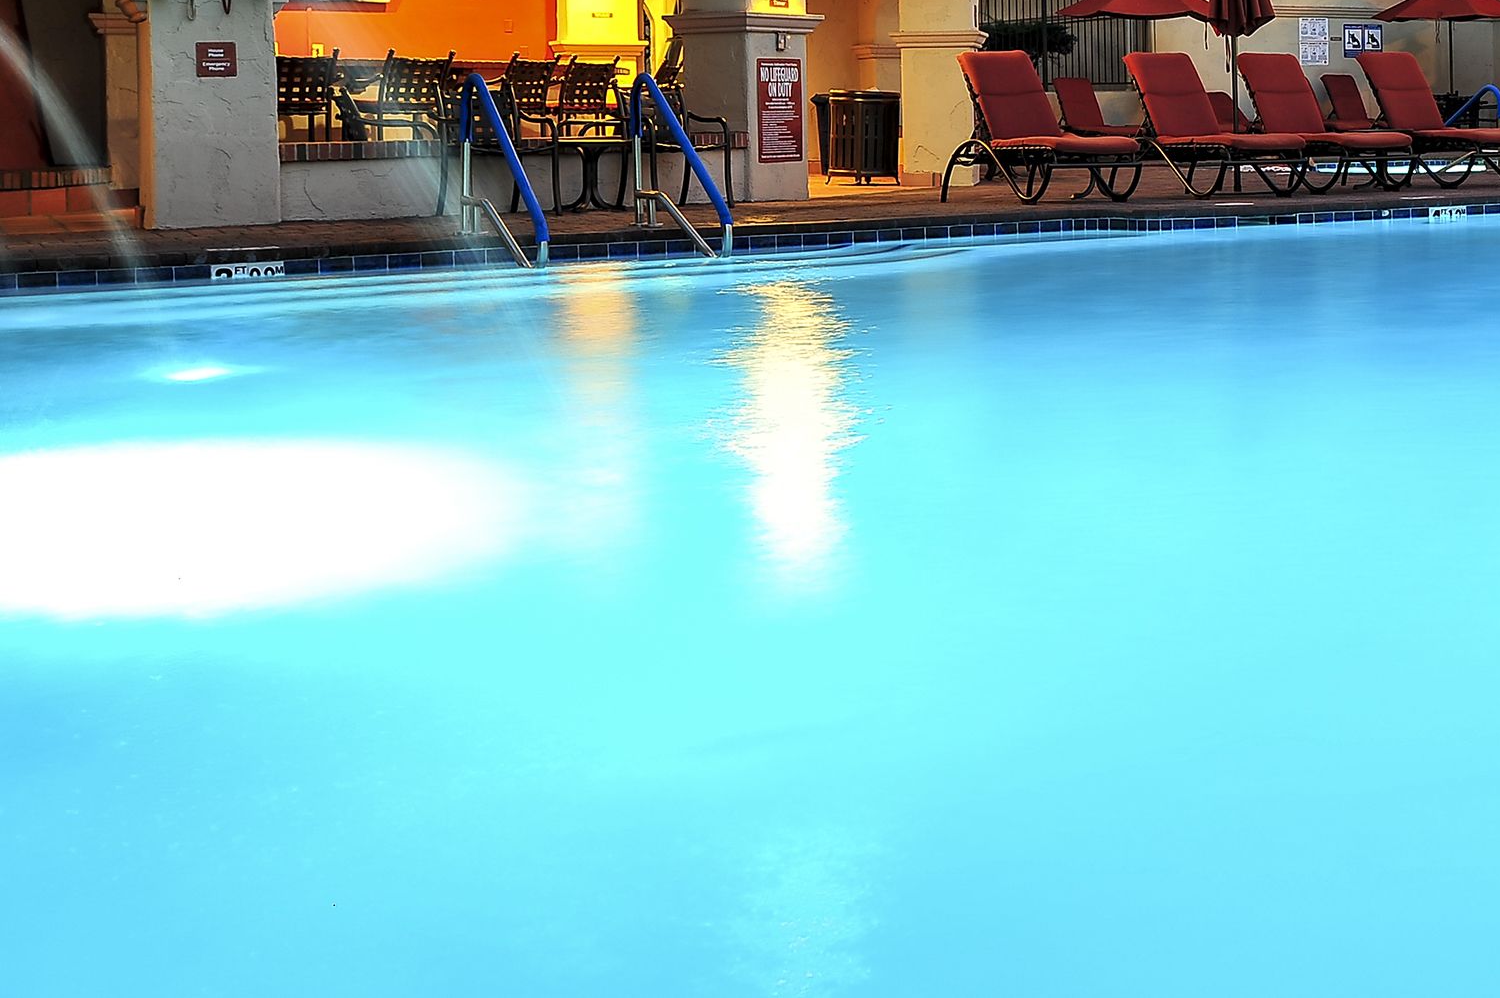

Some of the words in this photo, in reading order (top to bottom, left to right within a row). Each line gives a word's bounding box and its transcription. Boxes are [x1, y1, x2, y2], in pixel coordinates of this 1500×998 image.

[760, 67, 769, 82] NO
[769, 67, 799, 82] LIFEGUARD
[768, 82, 777, 97] ON
[777, 82, 792, 97] DUTY
